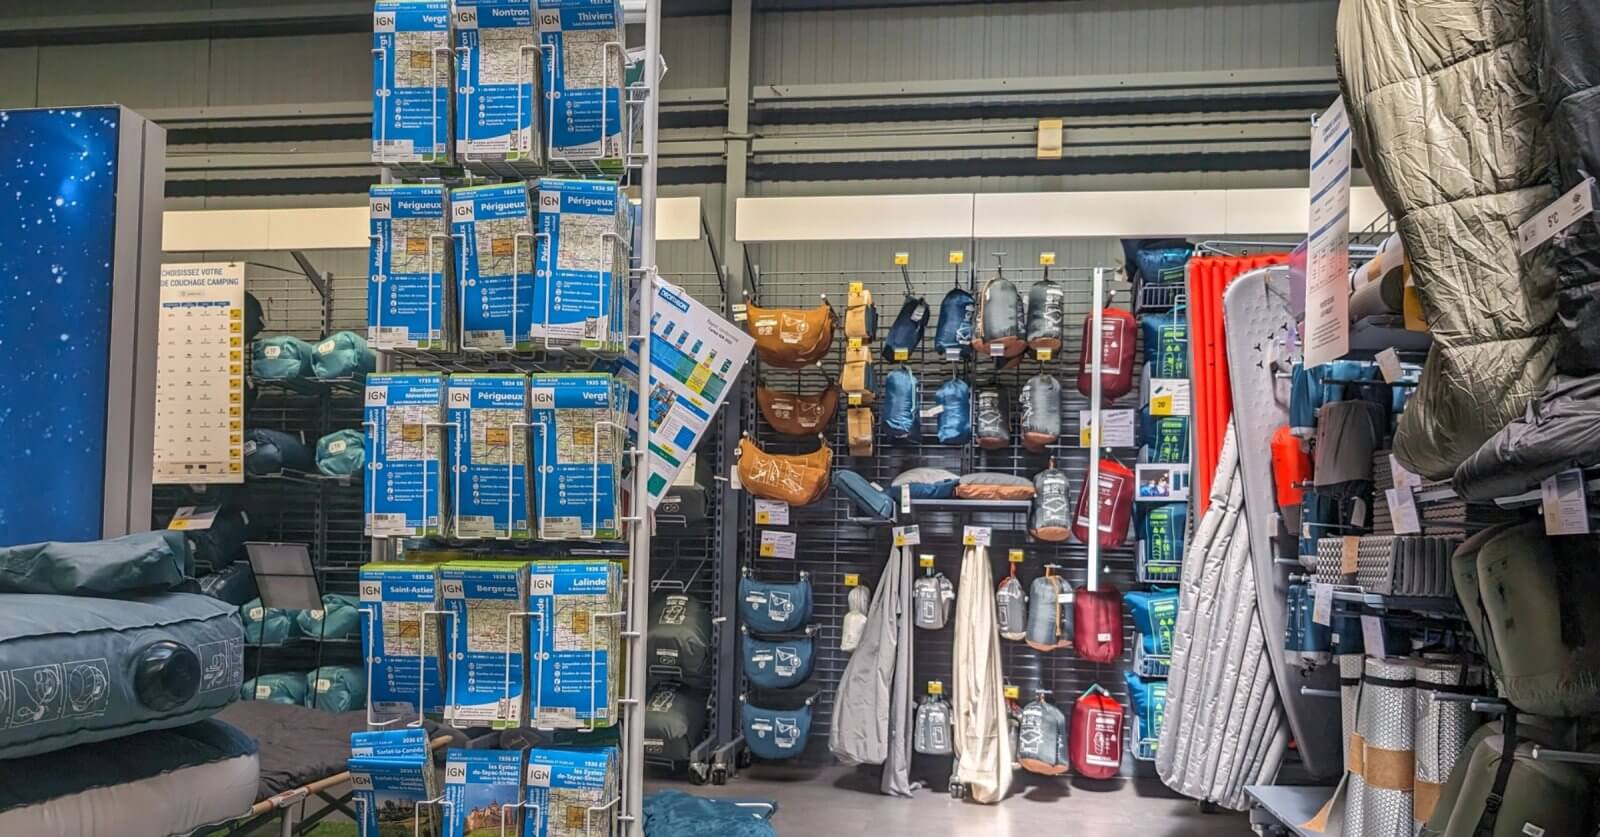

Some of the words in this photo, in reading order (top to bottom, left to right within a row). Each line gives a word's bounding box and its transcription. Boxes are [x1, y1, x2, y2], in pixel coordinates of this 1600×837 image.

[457, 12, 476, 23] IGN
[492, 8, 529, 17] Nontron
[577, 11, 613, 22] Thiviers
[376, 16, 394, 26] IGN
[423, 15, 447, 24] Vergt
[540, 14, 559, 25] IGN
[398, 200, 442, 211] Périgueux
[540, 196, 559, 206] IGN
[567, 194, 613, 207] Périgueux
[372, 202, 390, 212] IGN
[455, 205, 473, 216] IGN
[480, 200, 525, 212] Périgueux
[201, 268, 224, 276] VOTRE
[170, 279, 206, 288] COUCHAGE
[207, 278, 239, 287] CAMPING
[368, 391, 386, 401] IGN
[451, 392, 470, 402] IGN
[478, 391, 523, 402] Périgueux
[534, 392, 553, 402] IGN
[582, 391, 608, 401] Vergt
[534, 579, 552, 589] IGN
[572, 577, 607, 587] Lalinde
[362, 585, 381, 595] IGN
[389, 585, 434, 594] Saint-Astier
[443, 583, 462, 593] IGN
[476, 584, 517, 594] Bergerac
[447, 767, 465, 777] IGN
[530, 769, 550, 780] IGN
[351, 776, 372, 786] IGN
